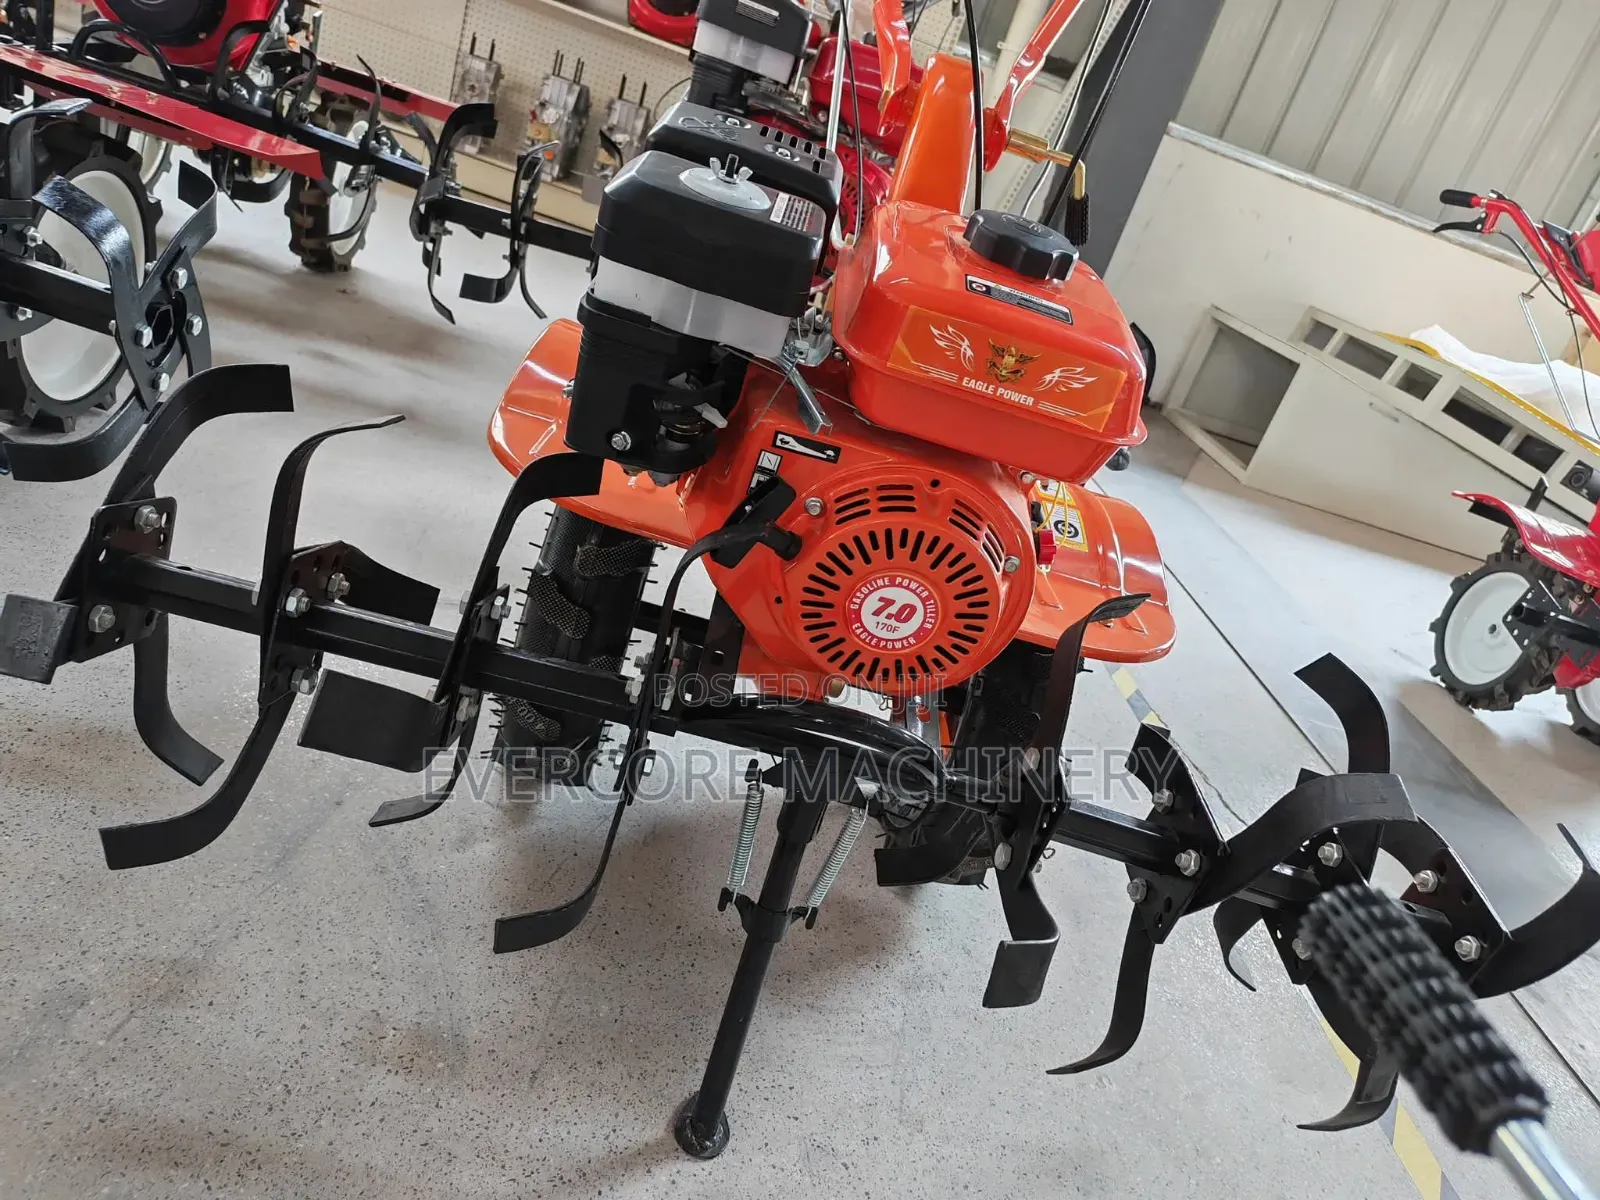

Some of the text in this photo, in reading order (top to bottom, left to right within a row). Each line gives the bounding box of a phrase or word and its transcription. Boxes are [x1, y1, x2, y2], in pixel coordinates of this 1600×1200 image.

[962, 377, 1034, 406] EAGLE POWER
[850, 577, 937, 630] GASOLINE POWER TILLER
[871, 596, 918, 624] 7.0
[852, 622, 917, 649] EAGLE POWER
[875, 621, 901, 634] 170F
